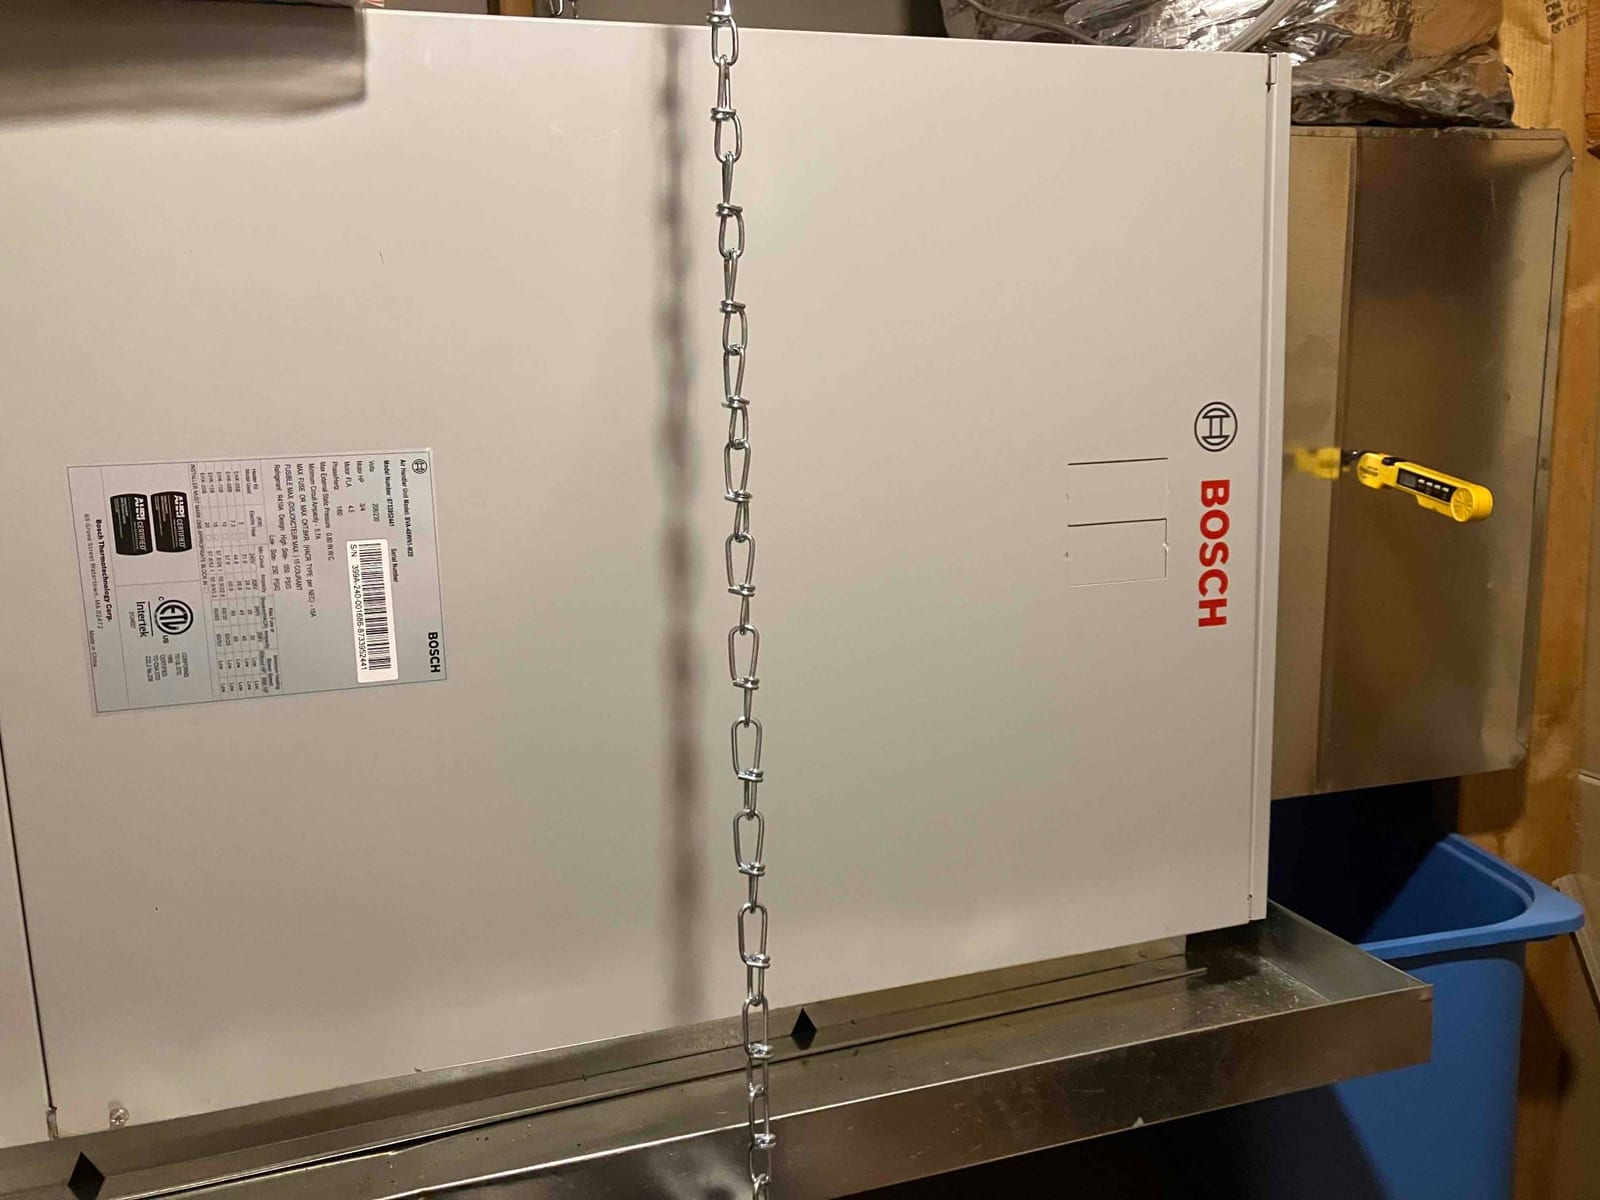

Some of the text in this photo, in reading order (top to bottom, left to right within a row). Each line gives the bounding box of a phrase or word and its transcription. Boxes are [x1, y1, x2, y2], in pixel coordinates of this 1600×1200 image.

[284, 464, 292, 486] FUSIBLE
[319, 462, 327, 472] Max
[331, 461, 340, 490] Phase/Hertz
[357, 475, 364, 483] HP
[173, 495, 185, 518] AHRI
[276, 495, 284, 510] R410A
[299, 494, 306, 502] OR
[322, 493, 330, 506] Static
[83, 513, 91, 522] 65
[134, 497, 146, 520] AHRI
[311, 502, 319, 523] Ampacity
[323, 507, 332, 528] Pressure
[287, 502, 297, 540] (DISJONCTEUR
[85, 523, 93, 541] Grove
[136, 521, 147, 549] CERTIFIED
[175, 519, 186, 547] CERTIFIED
[279, 534, 287, 546] High
[87, 542, 96, 561] Street
[197, 531, 205, 562] APPROPRIATE
[303, 545, 311, 561] (HACR
[1198, 479, 1230, 627] BOSCH
[95, 519, 113, 622] Bosch Thermotechnology Corp.
[293, 565, 302, 591] COURANT
[305, 563, 313, 577] TYPE
[391, 563, 399, 582] Number
[284, 577, 292, 590] PSIG
[94, 600, 101, 609] MA
[307, 589, 315, 603] NEC)
[95, 610, 104, 630] 02472
[135, 601, 149, 637] Intertek
[88, 630, 96, 645] Made
[162, 635, 169, 644] US
[91, 652, 99, 667] China
[427, 631, 440, 673] BOSCH
